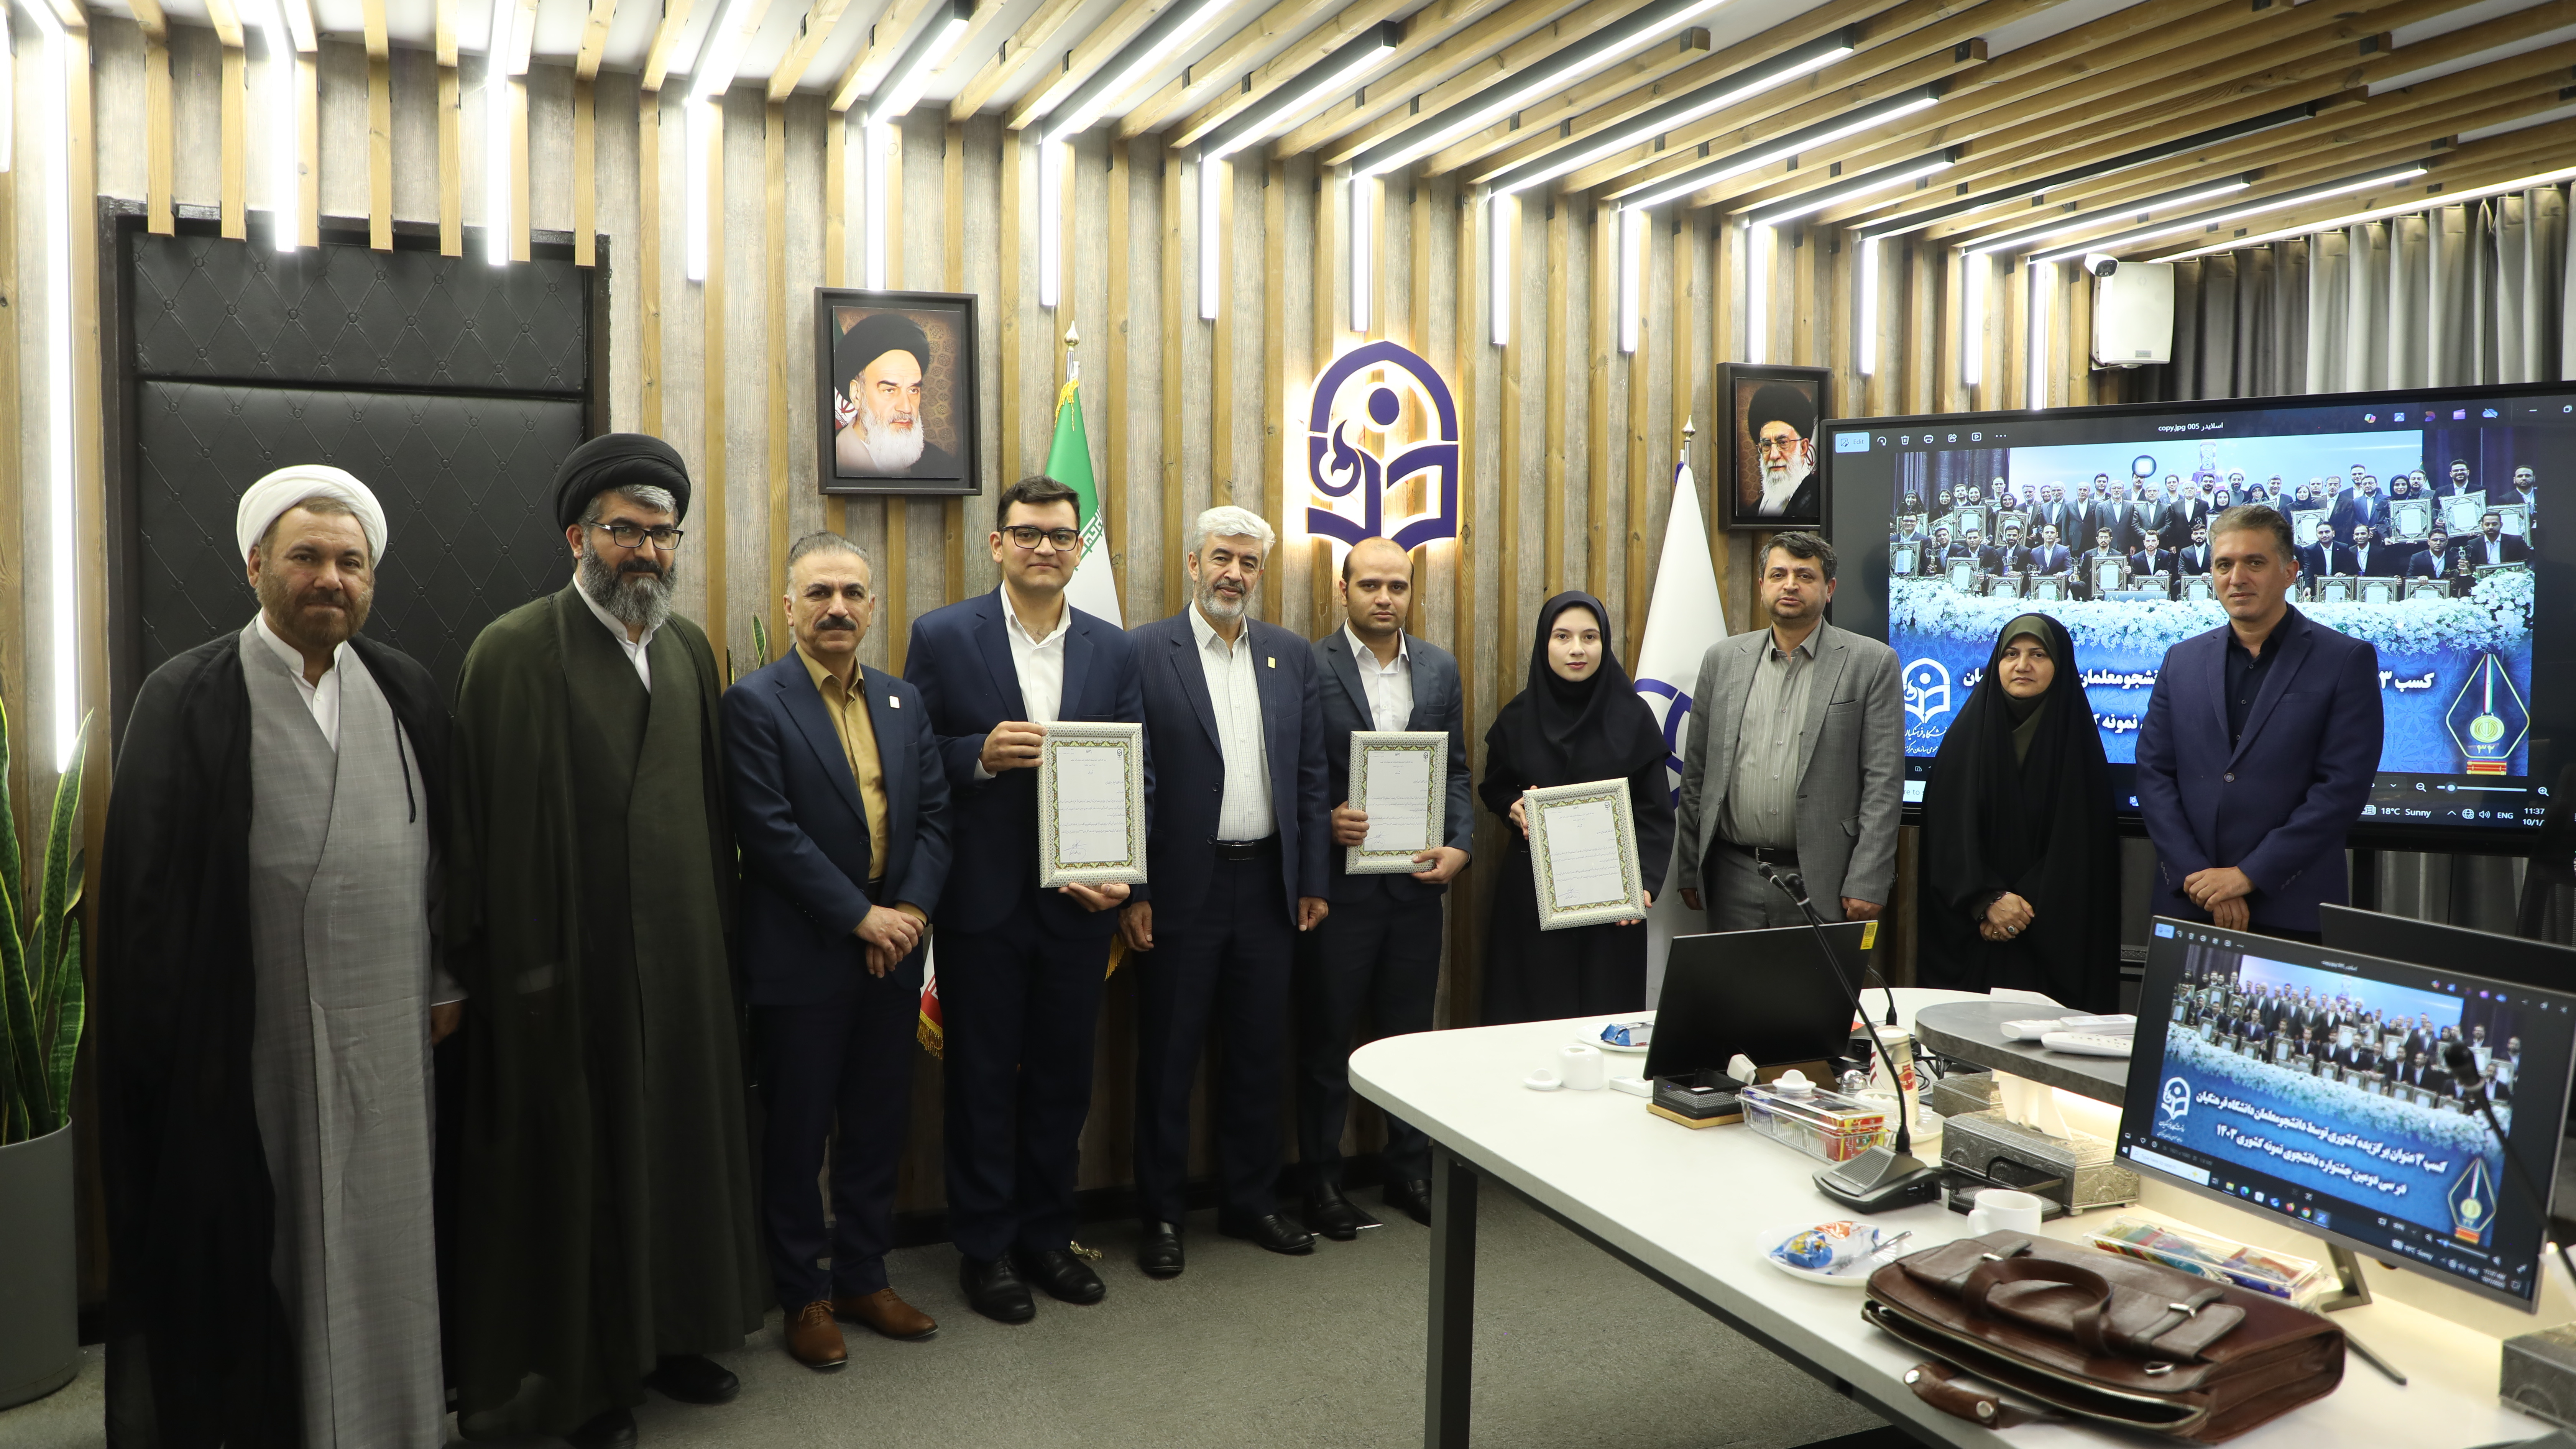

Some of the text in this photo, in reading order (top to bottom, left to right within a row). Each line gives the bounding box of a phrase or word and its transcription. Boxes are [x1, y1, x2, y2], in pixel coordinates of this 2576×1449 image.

[2201, 422, 2223, 431] اسلایدر
[2379, 670, 2435, 692] کسب ۳
[2102, 713, 2138, 734] نمونه
[2381, 807, 2431, 818] 18°C Sunny
[2196, 1091, 2228, 1109] فرهنگیان
[2228, 1099, 2255, 1115] دانشگاه
[2306, 1121, 2330, 1140] توسط
[2236, 1135, 2265, 1149] کشوری
[2327, 1132, 2359, 1147] کشوری
[2263, 1140, 2284, 1155] نمونه
[2389, 1147, 2416, 1165] عنوان
[2423, 1160, 2449, 1173] کسب
